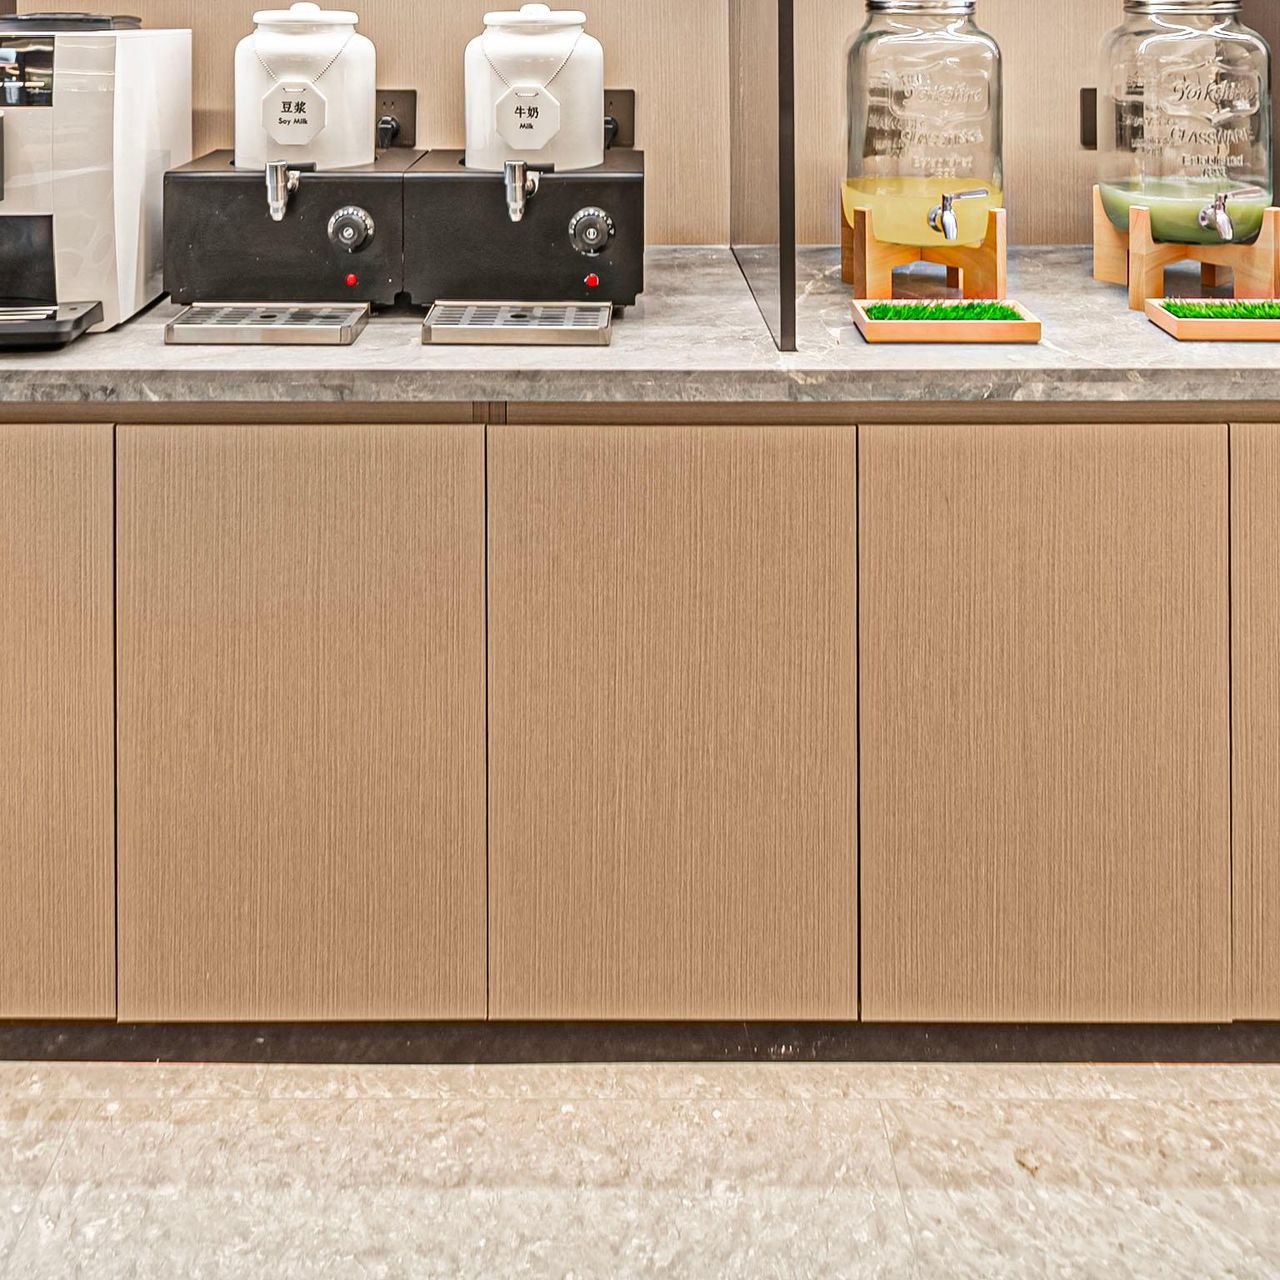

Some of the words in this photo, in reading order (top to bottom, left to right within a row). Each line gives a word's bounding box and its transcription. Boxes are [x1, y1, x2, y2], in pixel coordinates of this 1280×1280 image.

[280, 100, 307, 114] 豆浆
[514, 105, 539, 119] 牛奶
[278, 117, 291, 126] Soy
[293, 117, 308, 125] Milk
[519, 122, 534, 130] Milk
